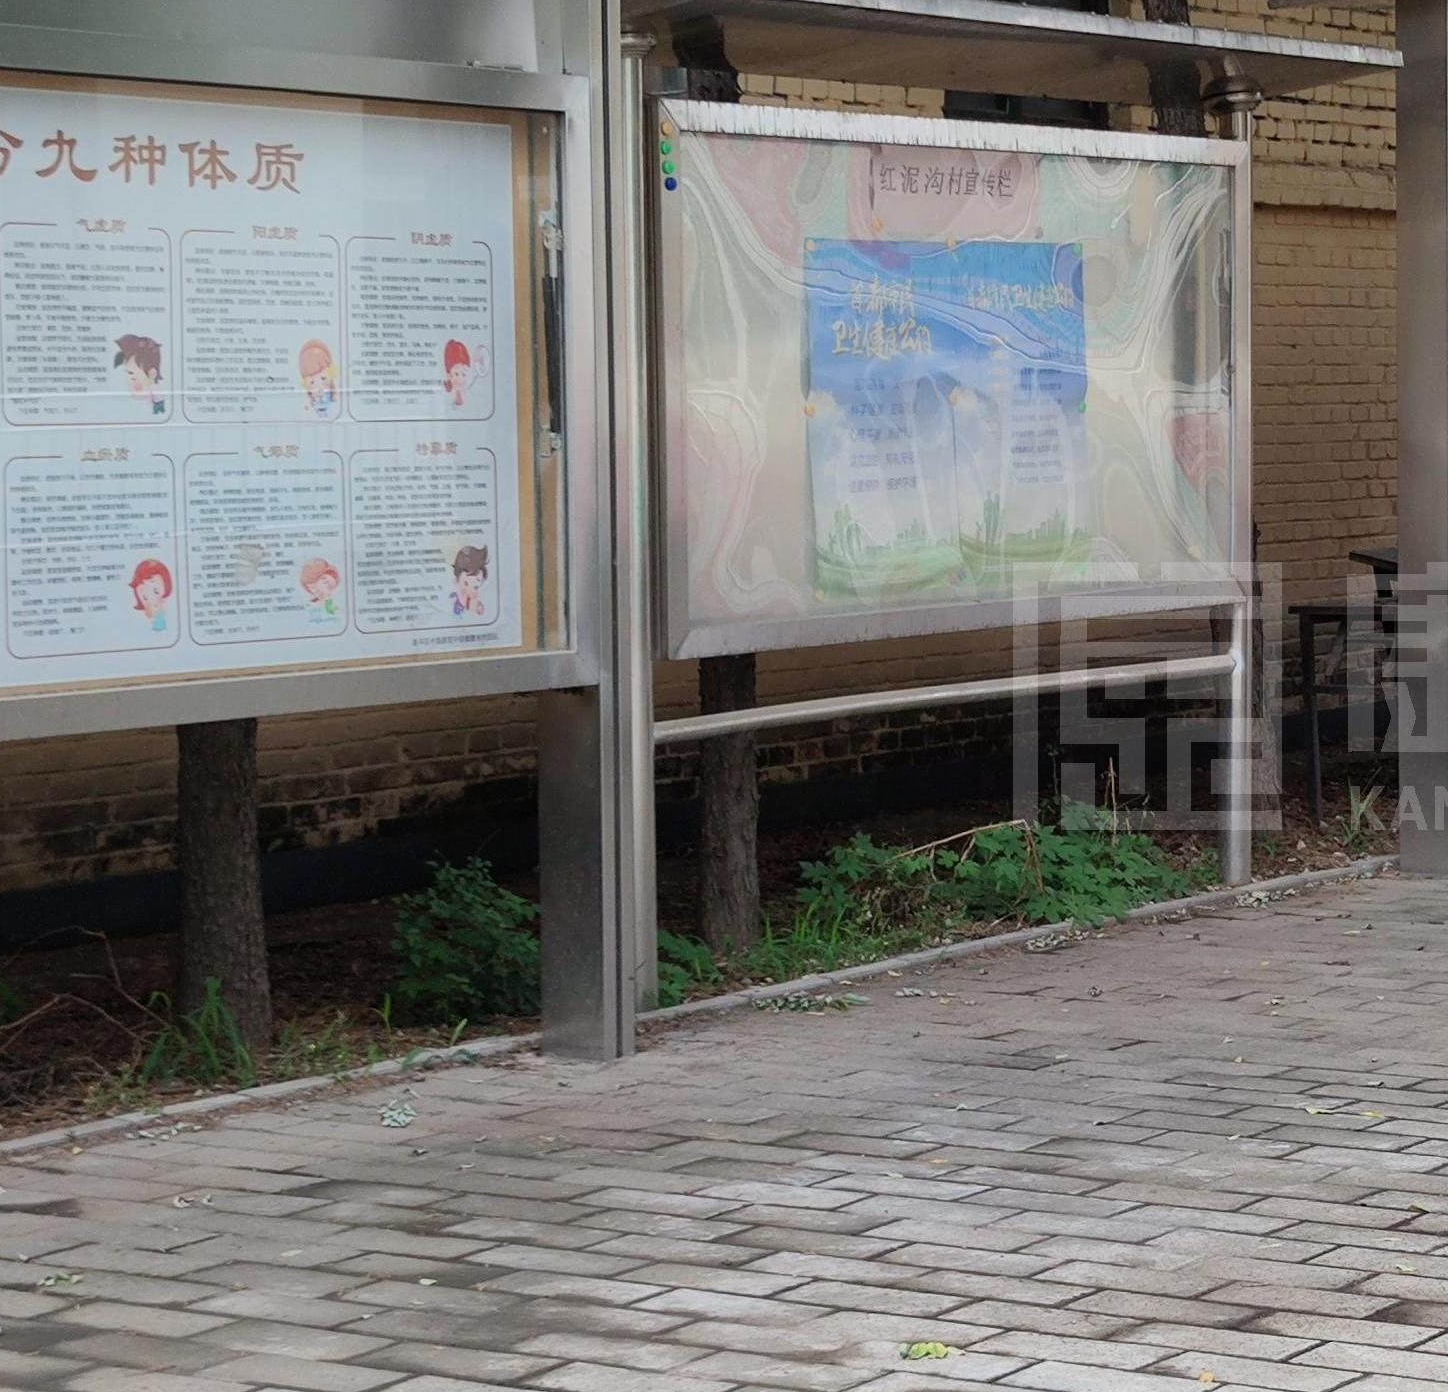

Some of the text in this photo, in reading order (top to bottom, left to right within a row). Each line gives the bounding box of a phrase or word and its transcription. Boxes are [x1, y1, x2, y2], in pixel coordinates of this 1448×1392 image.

[879, 163, 1013, 198] 红泥沟村宣传栏
